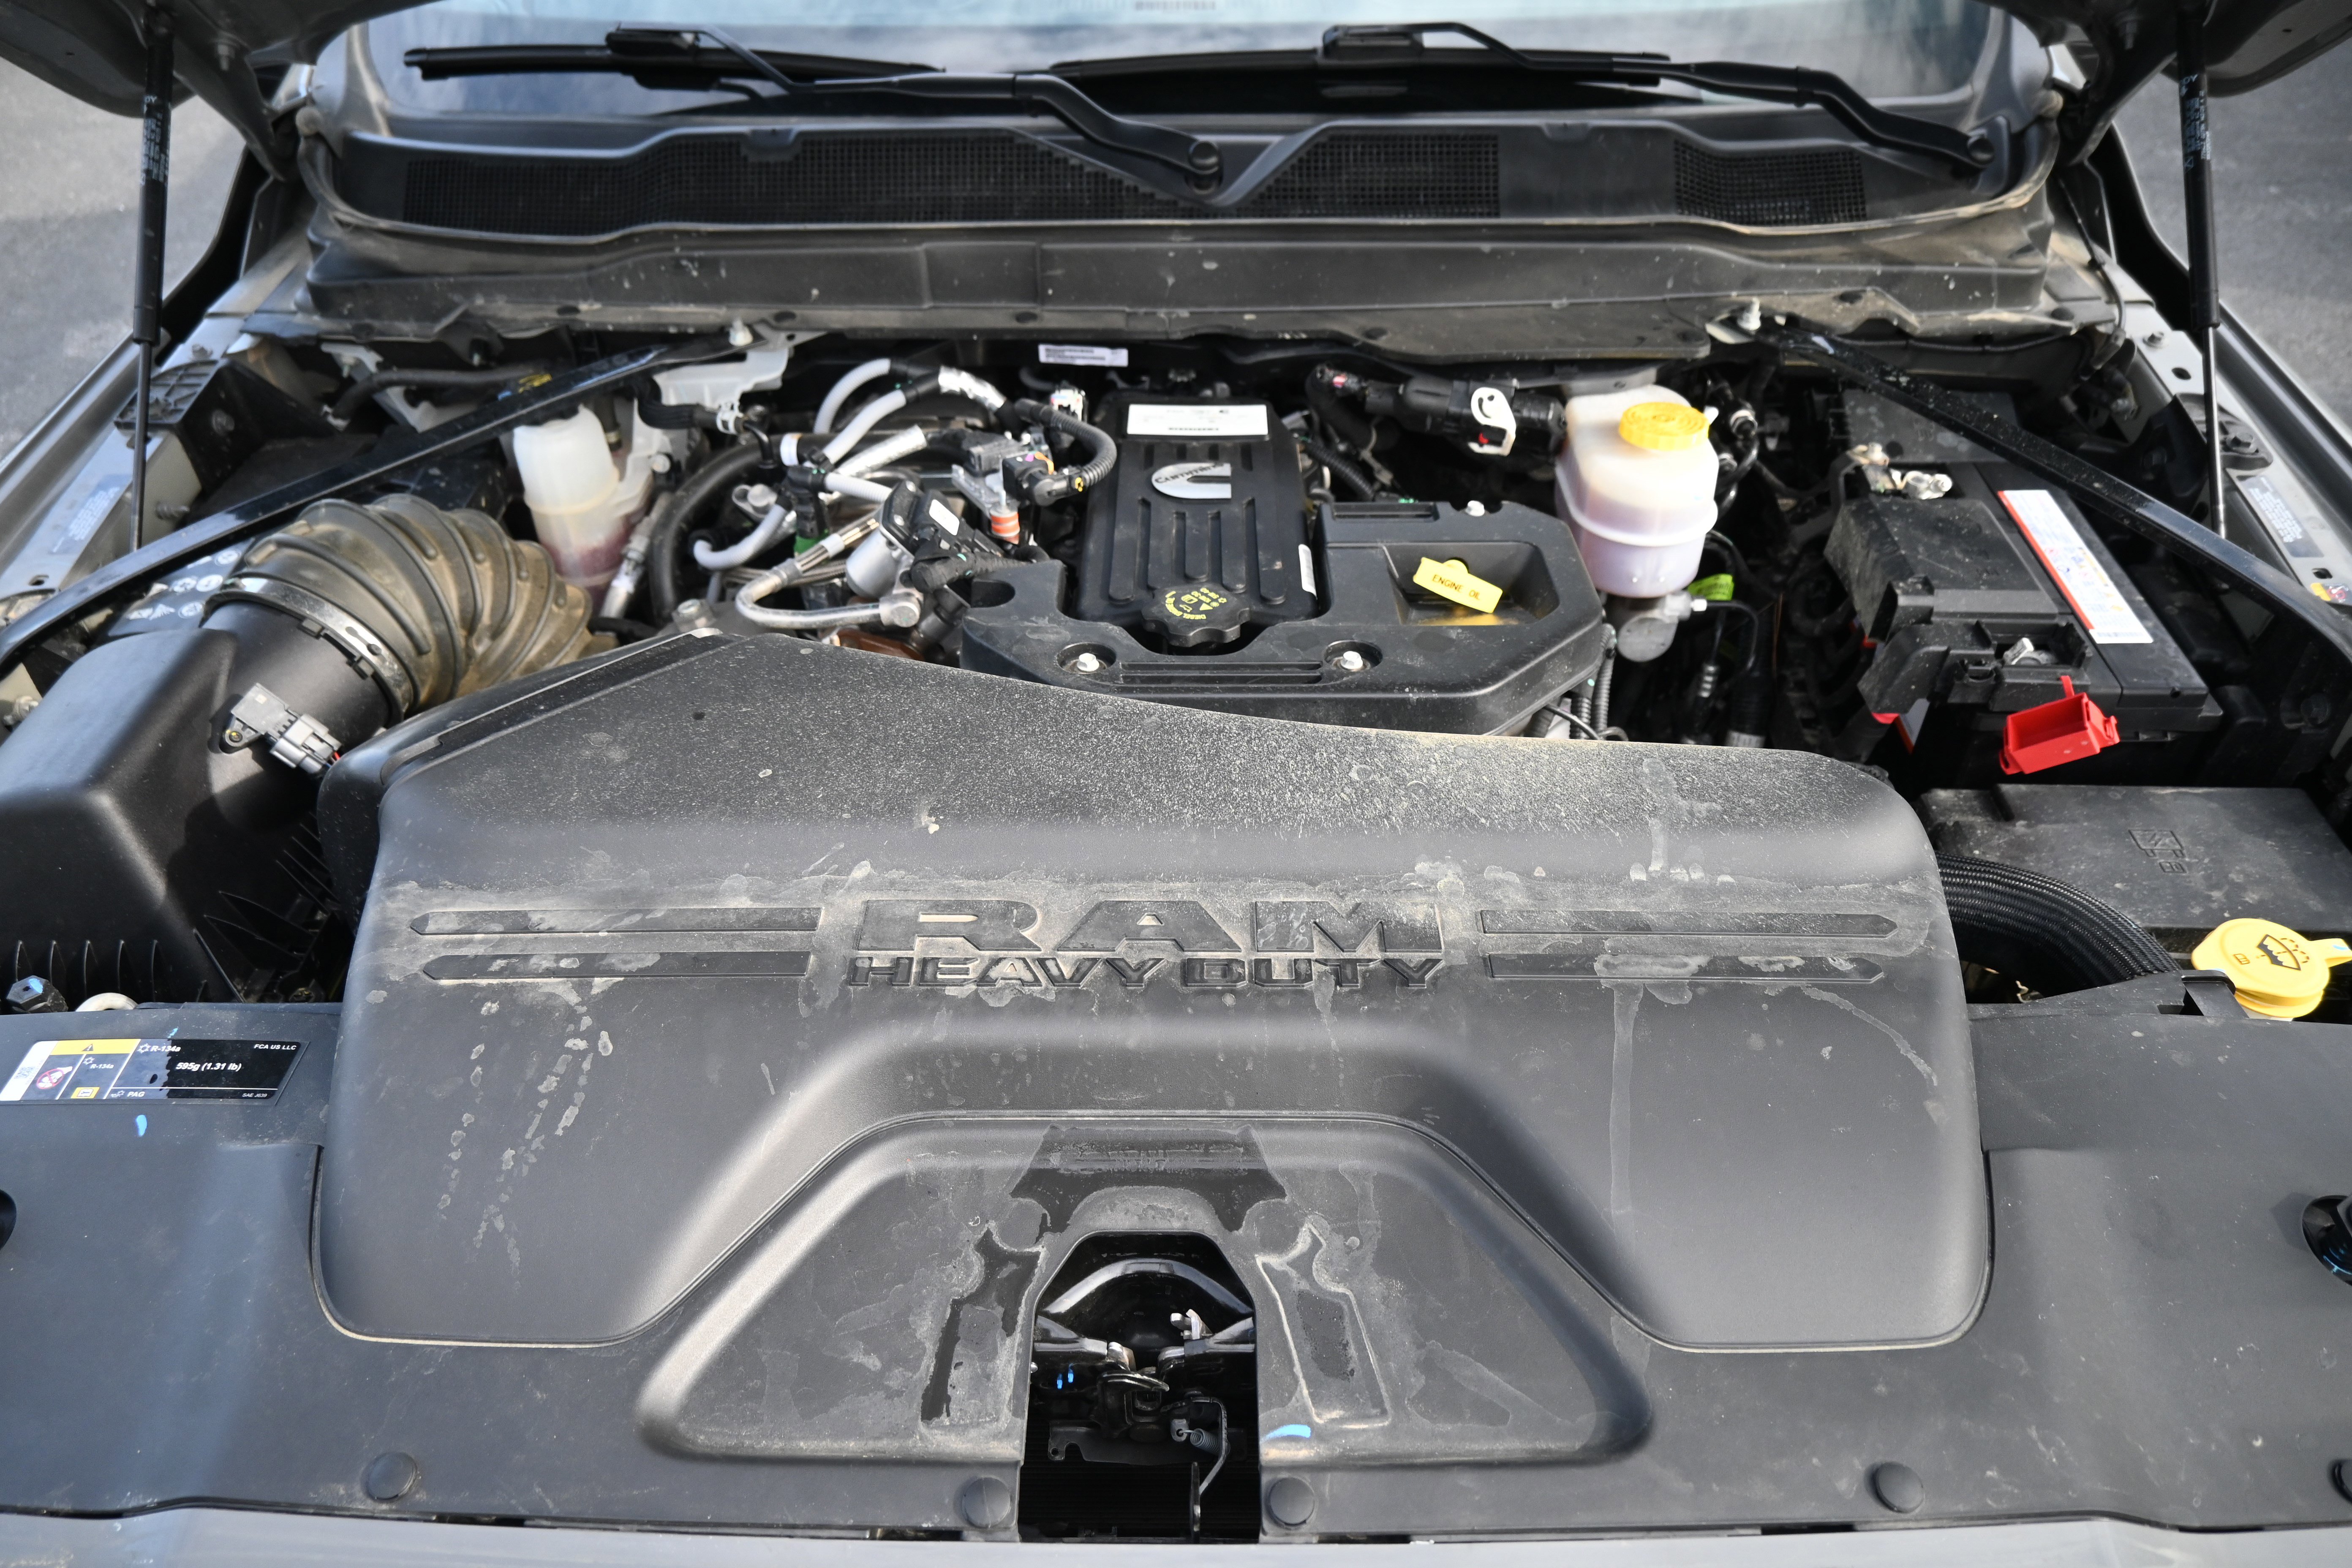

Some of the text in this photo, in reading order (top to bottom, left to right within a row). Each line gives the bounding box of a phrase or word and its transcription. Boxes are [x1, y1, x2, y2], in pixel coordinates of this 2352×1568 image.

[1432, 574, 1481, 600] ENGINE OIL
[856, 899, 1443, 953] RAM
[849, 956, 1445, 988] HEAVY DUTY
[175, 1062, 242, 1072] 595g (1.31 lb)
